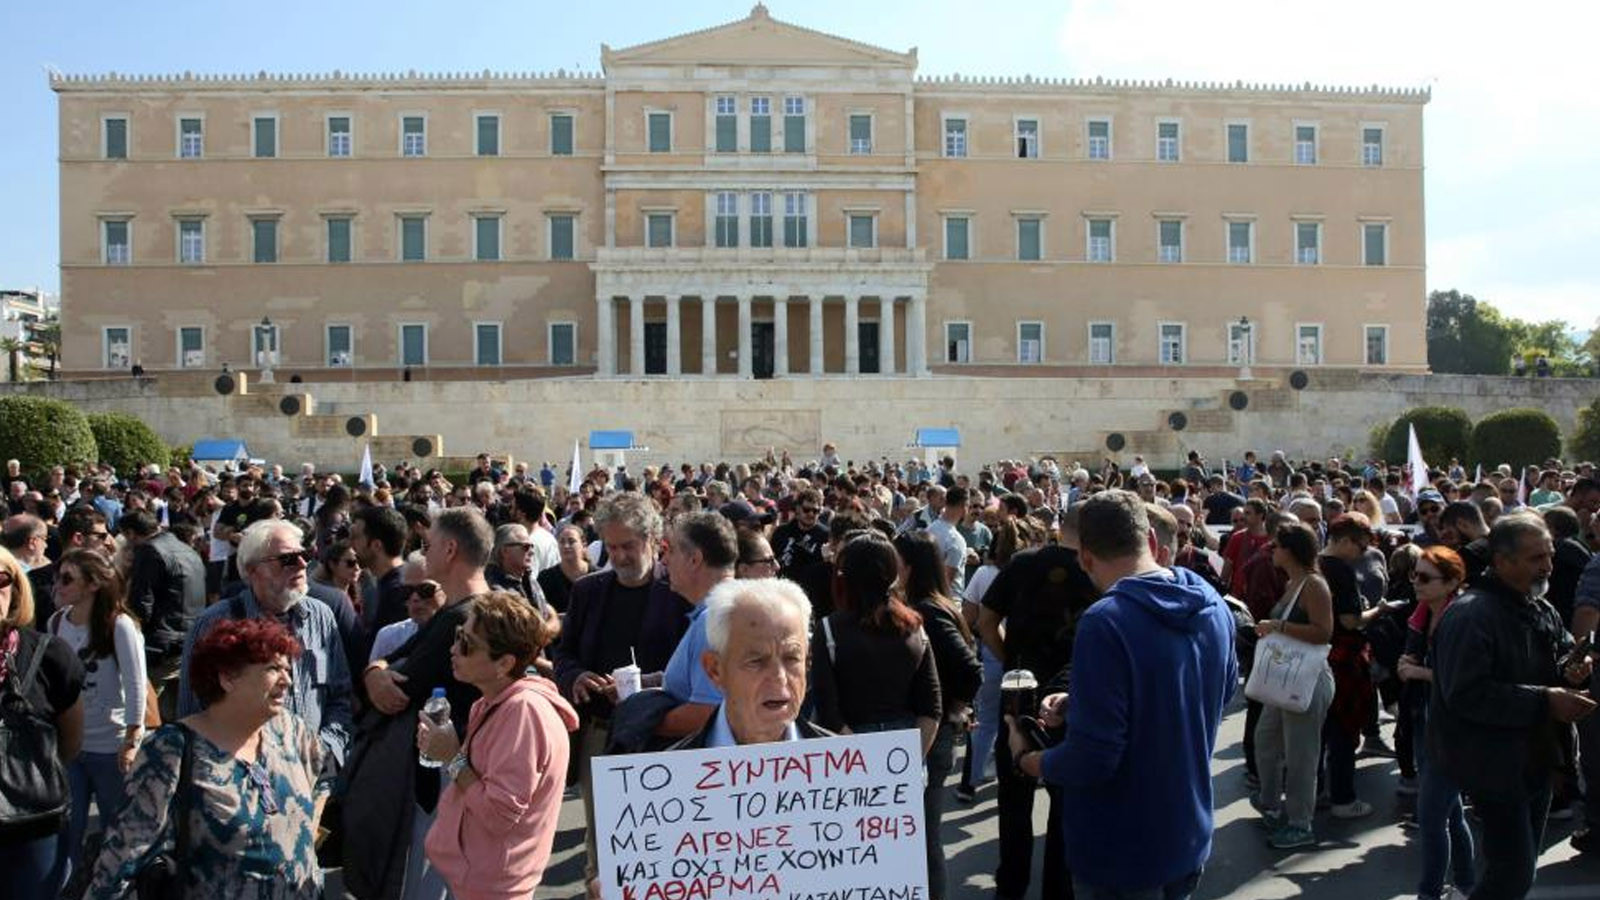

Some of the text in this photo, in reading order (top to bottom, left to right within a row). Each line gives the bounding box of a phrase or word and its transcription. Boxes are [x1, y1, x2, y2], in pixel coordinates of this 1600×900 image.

[609, 747, 909, 792] ΤΟ ΣΥΝΤΑΓΜΑ Ο
[615, 796, 712, 829] ΛΑΟΣ
[728, 792, 767, 820] ΤΟ
[610, 814, 917, 856] ΜΕ ΑΓΩΝΕΣ ΤΟ 1843
[616, 844, 879, 887] ΚΑΙ ΟΧΙ ΜΕ ΧΟΥΝΤΑ
[622, 873, 780, 900] ΚΑΘΑΡΜΑ
